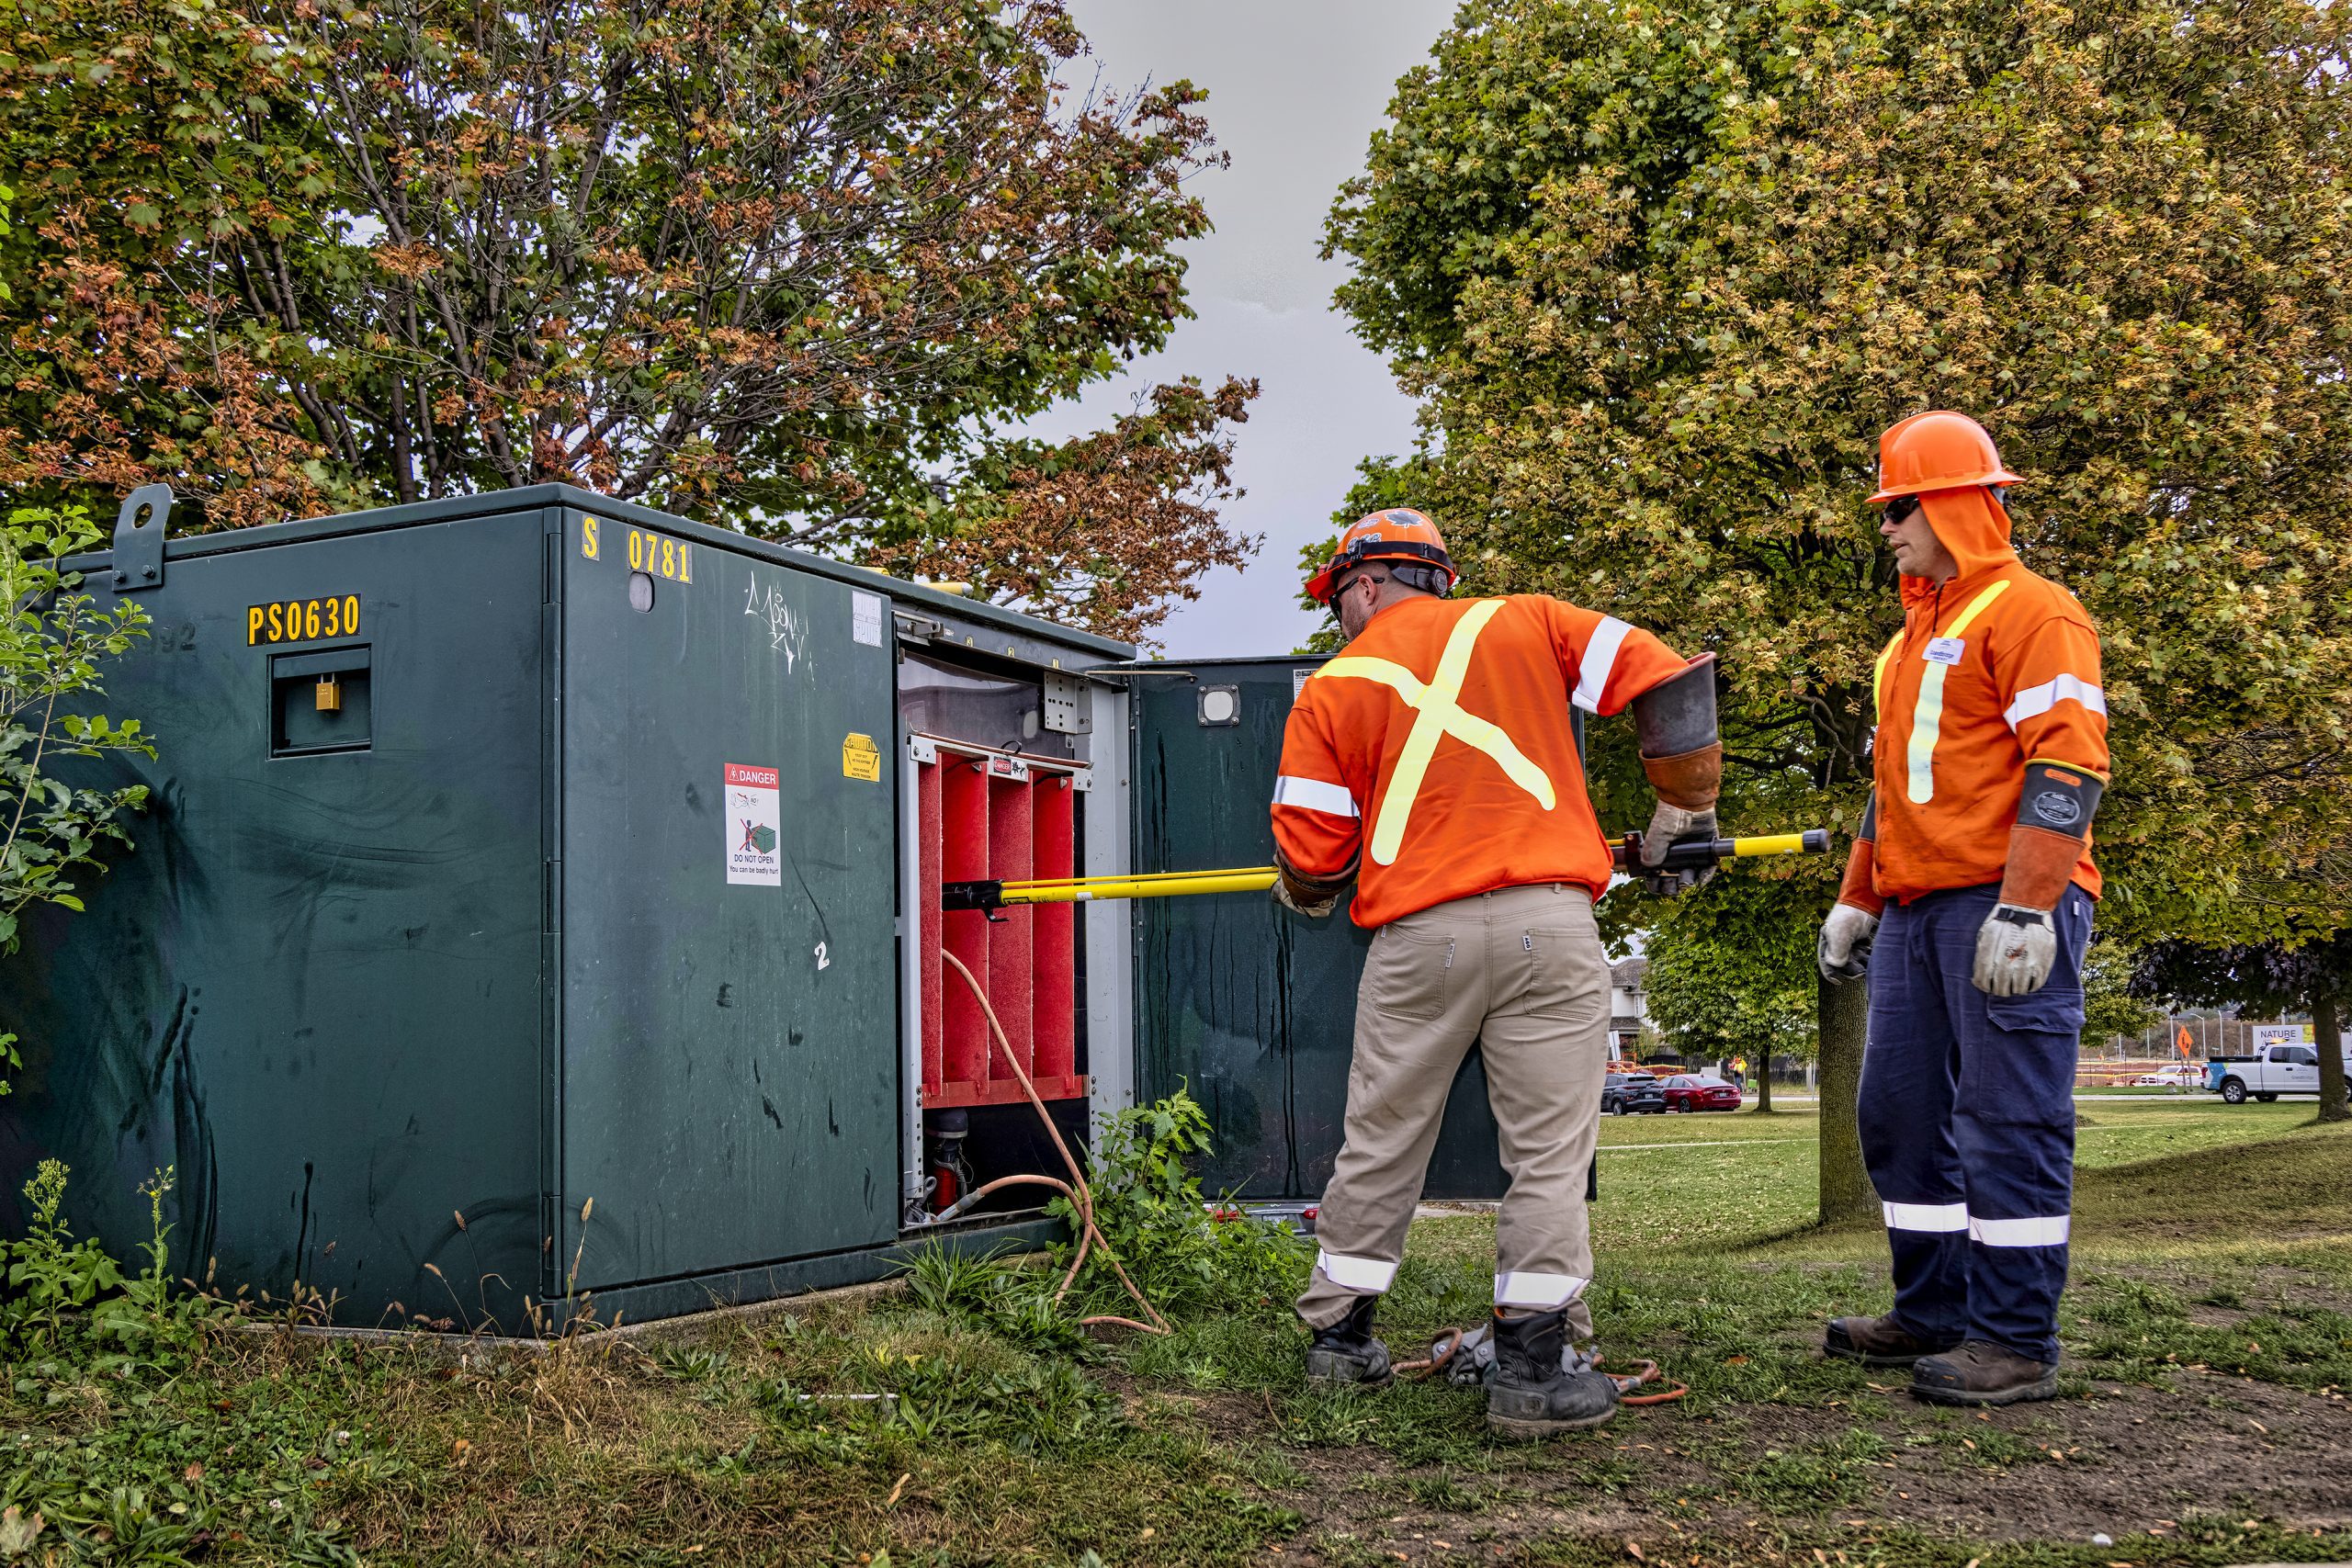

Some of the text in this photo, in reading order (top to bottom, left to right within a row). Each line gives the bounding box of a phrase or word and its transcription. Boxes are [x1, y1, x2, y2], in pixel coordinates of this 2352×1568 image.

[583, 516, 689, 582] S 0781
[249, 594, 359, 645] PS0630
[740, 770, 776, 785] DANGER
[734, 853, 775, 864] DO NOT OPEN
[729, 864, 739, 873] You
[755, 866, 769, 875] badly
[769, 867, 779, 875] hurt
[814, 941, 830, 971] 2
[2260, 1030, 2297, 1038] NATURE
